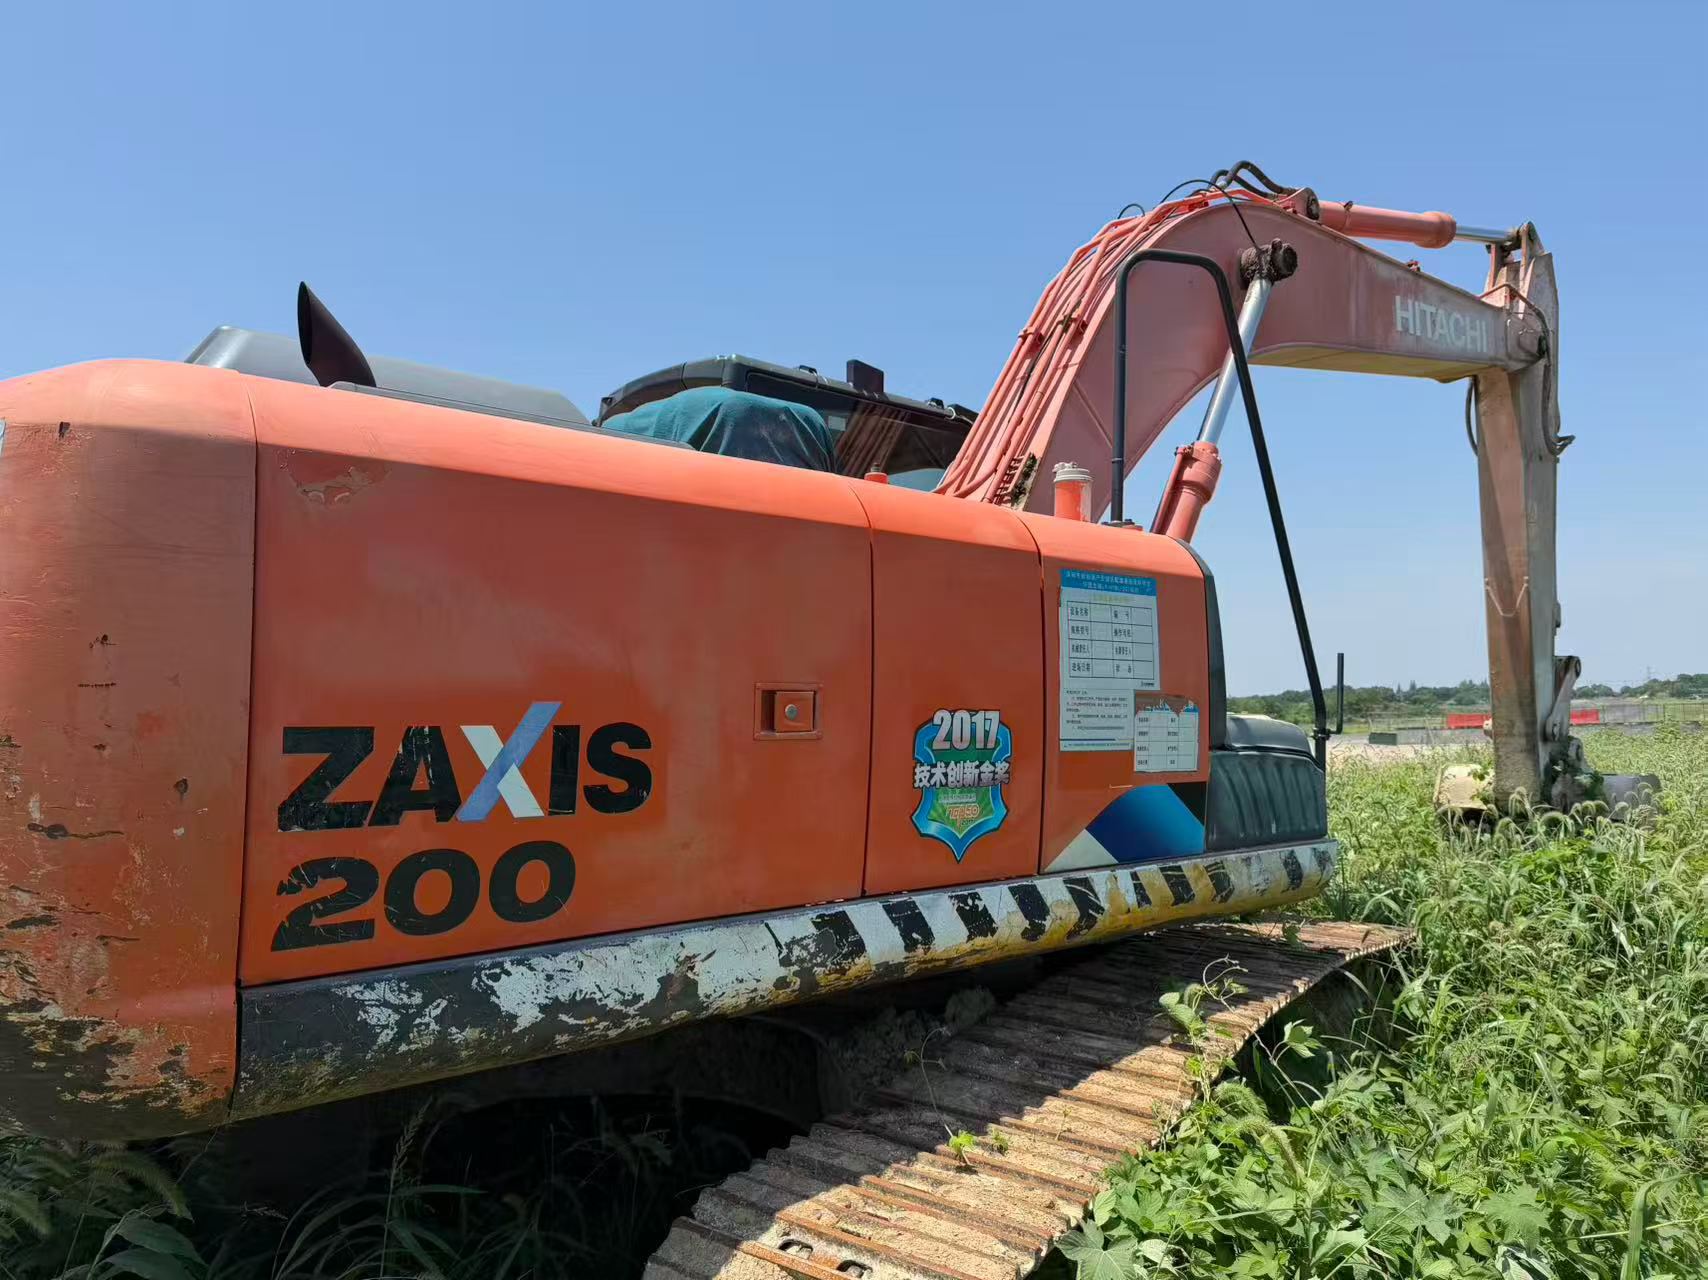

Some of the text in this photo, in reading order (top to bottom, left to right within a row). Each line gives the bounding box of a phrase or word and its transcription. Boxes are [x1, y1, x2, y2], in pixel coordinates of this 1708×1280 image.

[1395, 295, 1487, 353] HITACHI
[932, 709, 999, 750] 2017
[278, 701, 652, 832] ZAXIS
[914, 760, 1010, 788] 技术创新金奖
[271, 840, 577, 952] 200
